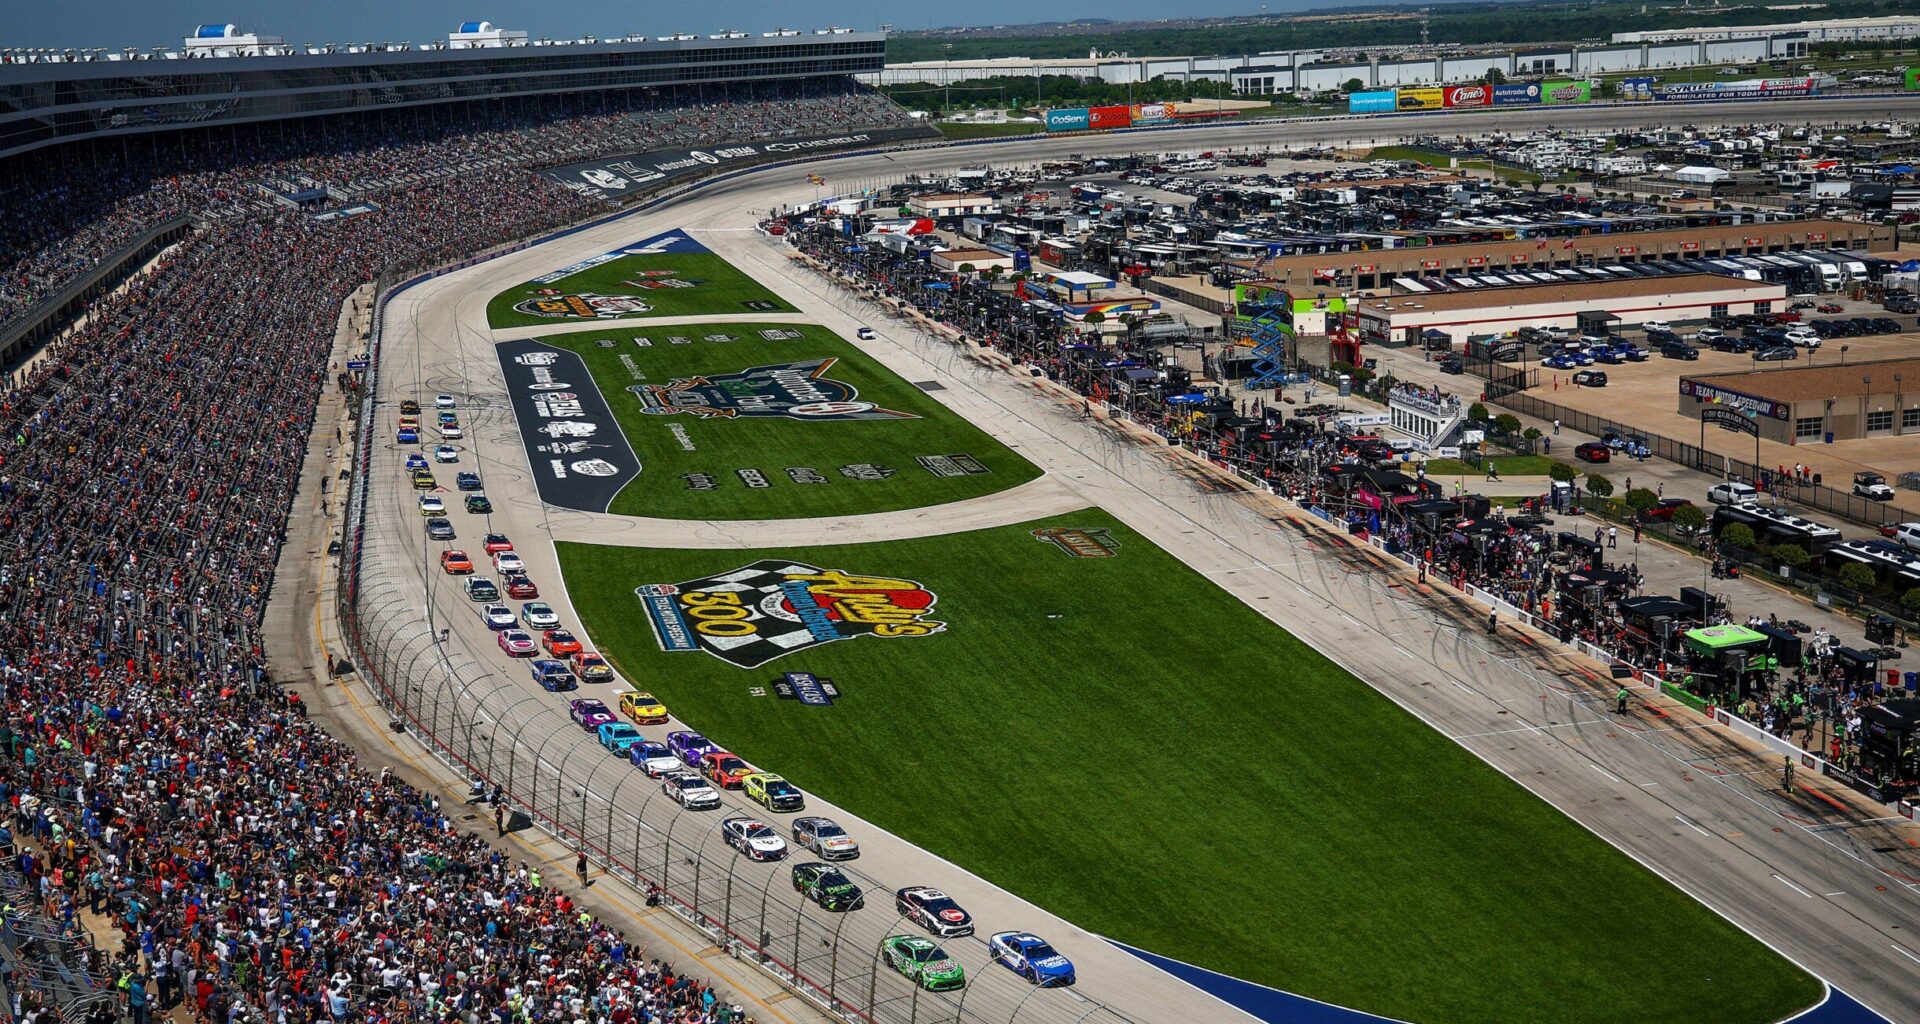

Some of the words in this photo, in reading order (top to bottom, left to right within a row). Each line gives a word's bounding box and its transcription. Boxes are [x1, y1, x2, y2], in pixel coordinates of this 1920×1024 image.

[1495, 88, 1527, 97] Autotrader
[1666, 82, 1714, 93] SYNTEC
[1450, 86, 1484, 104] Cane's
[1666, 92, 1717, 100] FORMULATED
[1771, 88, 1808, 96] ENGINES
[1051, 114, 1086, 125] CoServ
[798, 134, 871, 148] CHEVROLET
[730, 146, 757, 156] TEXAS
[654, 158, 700, 171] Autotrader
[1276, 249, 1282, 257] 5
[1295, 247, 1303, 256] 24
[1319, 245, 1326, 255] 9
[1341, 244, 1350, 253] 48
[1498, 343, 1517, 352] GARAGE
[770, 369, 834, 402] Autotrader
[667, 390, 711, 406] 400
[1695, 385, 1714, 398] TEXAS
[1715, 389, 1736, 402] MOTOR
[1737, 395, 1771, 414] SPEEDWAY
[551, 400, 586, 417] TEXAS
[1716, 409, 1742, 423] GARAGE
[782, 571, 945, 637] Andy's
[680, 590, 759, 637] 300
[748, 686, 767, 697] FS1
[1829, 768, 1854, 784] MENARDS
[825, 883, 855, 894] BEAST
